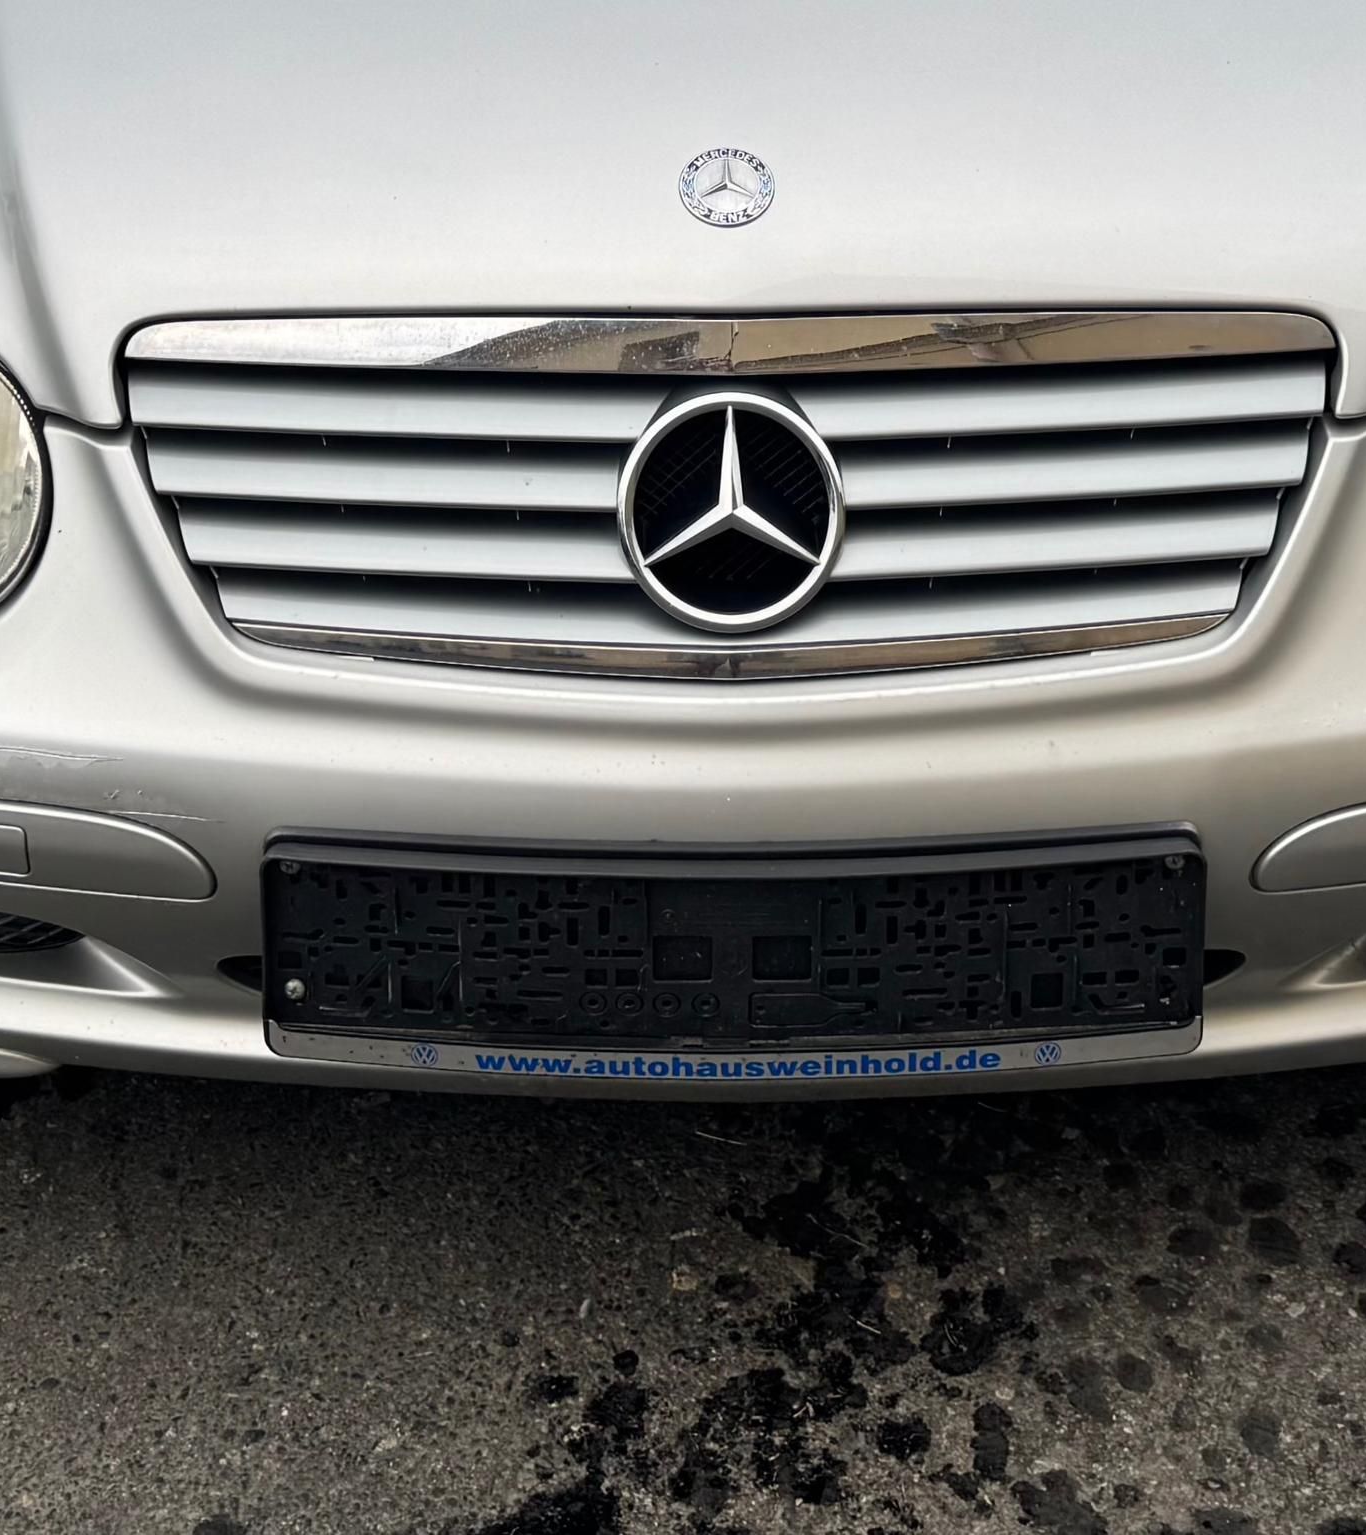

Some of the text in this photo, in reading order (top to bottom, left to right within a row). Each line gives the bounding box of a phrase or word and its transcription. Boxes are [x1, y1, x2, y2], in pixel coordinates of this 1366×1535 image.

[692, 148, 760, 169] MERCEDES
[709, 210, 748, 223] BENZ
[475, 1048, 1002, 1079] www.autohausweinhold.de
